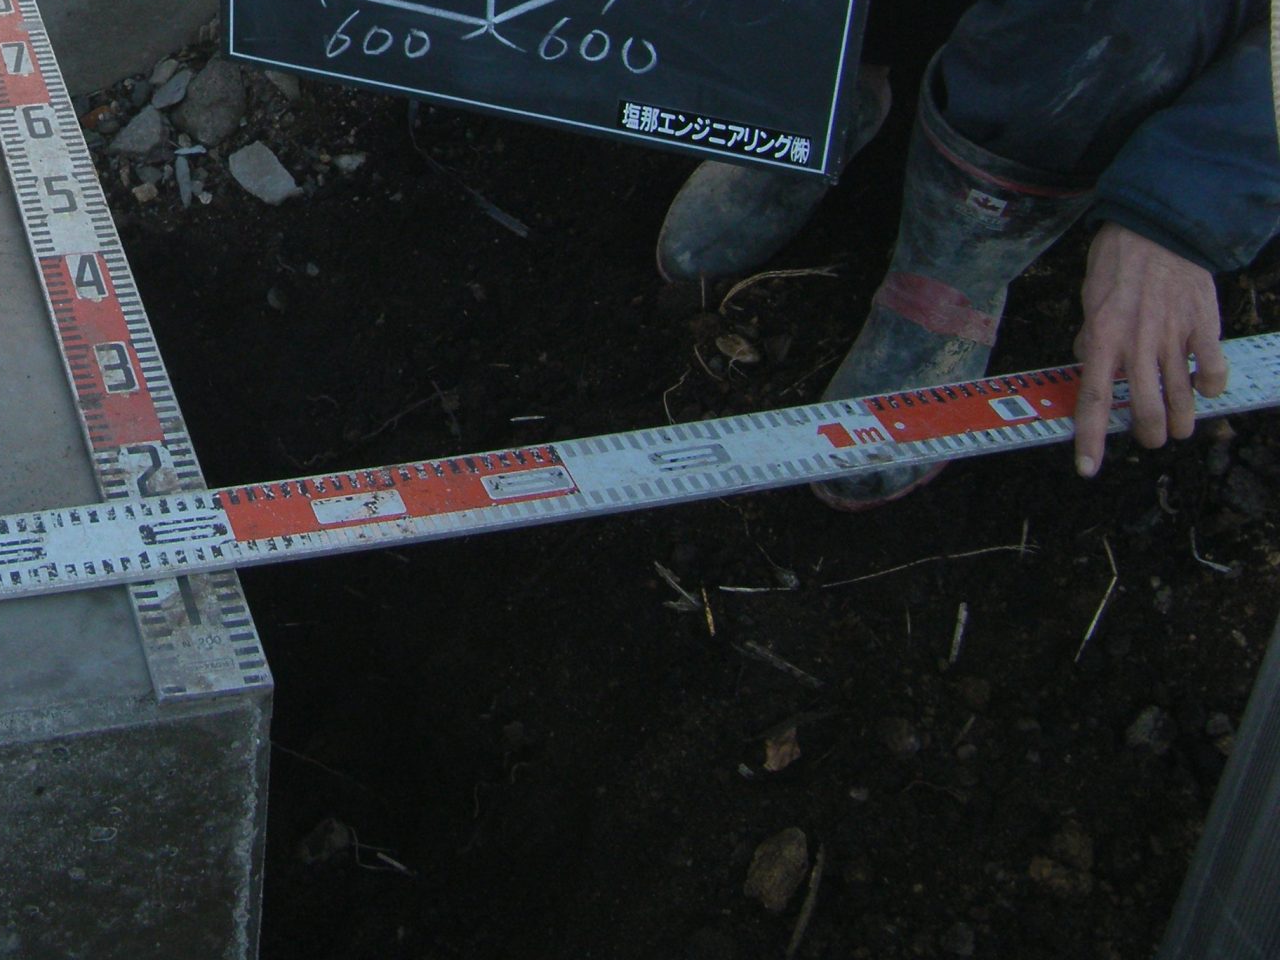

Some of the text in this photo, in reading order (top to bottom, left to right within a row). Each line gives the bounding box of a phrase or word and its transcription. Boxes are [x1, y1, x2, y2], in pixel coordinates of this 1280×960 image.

[325, 10, 432, 60] 600
[537, 16, 659, 74] 600
[1, 42, 26, 73] 7
[22, 105, 55, 140] 6
[43, 174, 78, 214] 5
[73, 253, 107, 297] 4
[94, 341, 139, 394] 3
